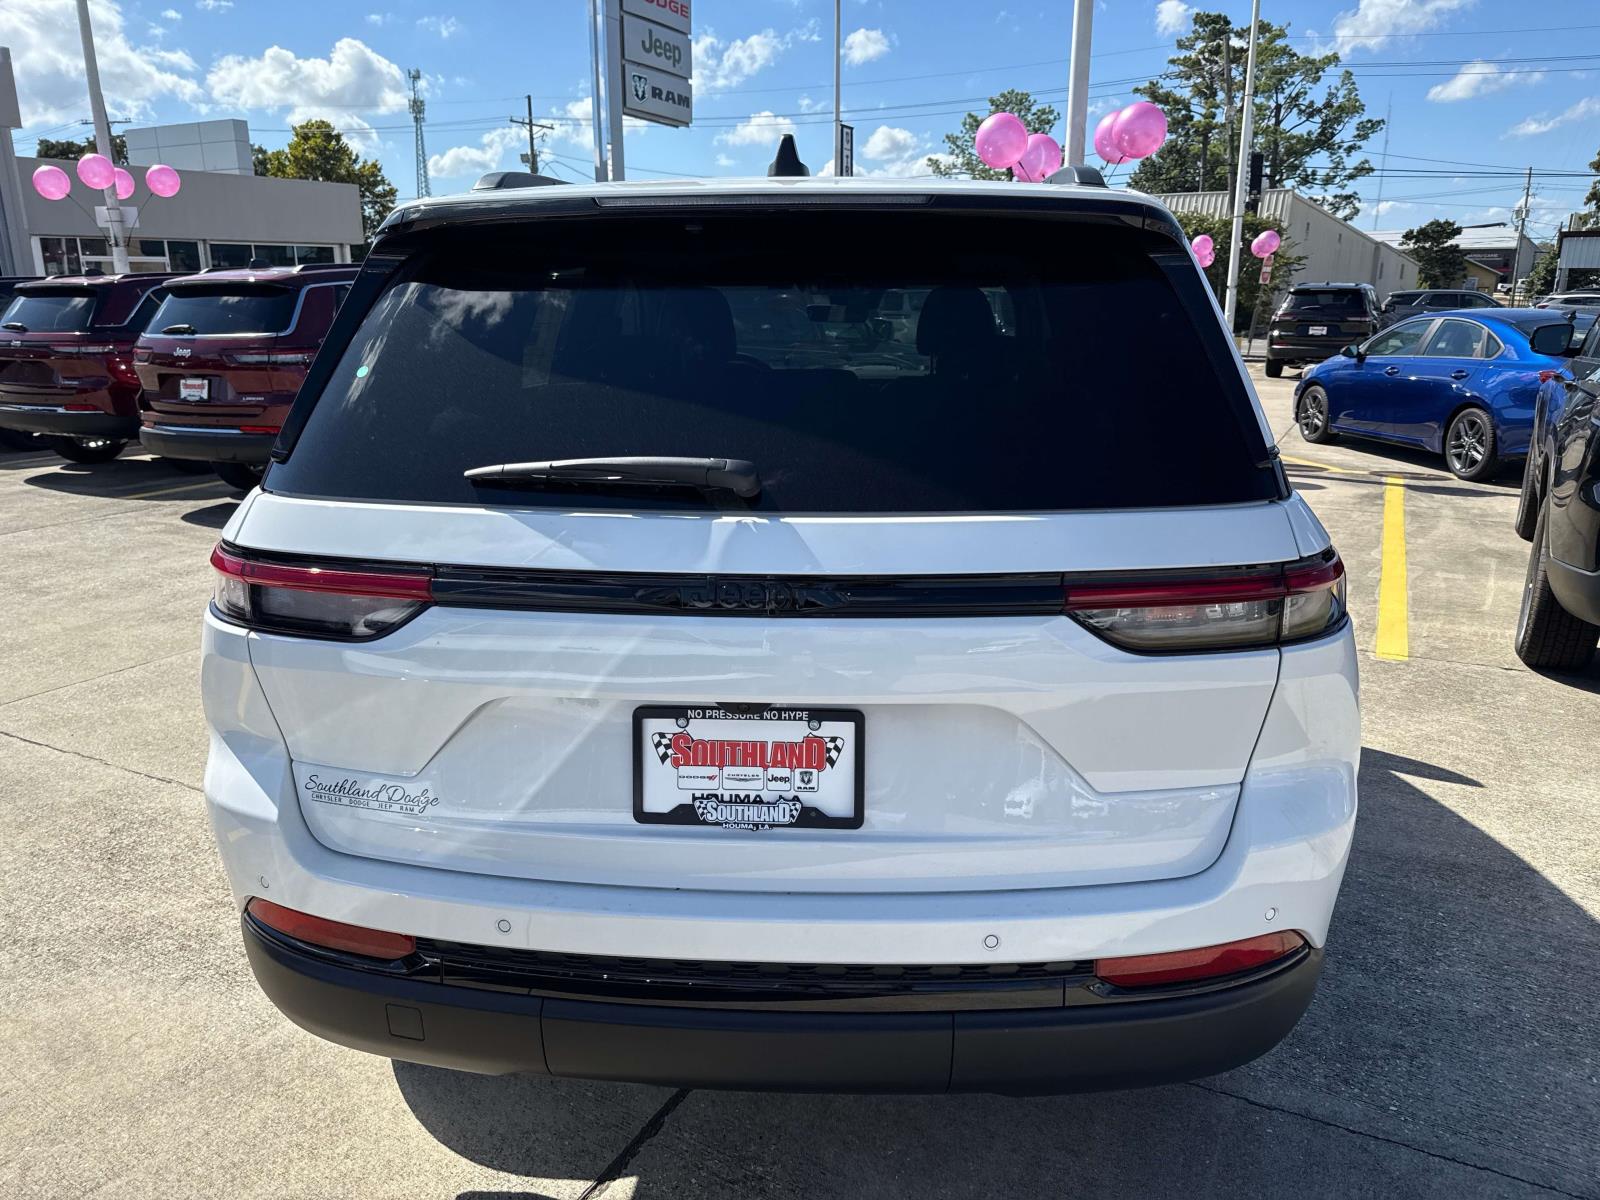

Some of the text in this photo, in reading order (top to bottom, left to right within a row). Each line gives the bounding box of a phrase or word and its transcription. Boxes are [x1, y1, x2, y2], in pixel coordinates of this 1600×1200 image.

[641, 28, 682, 67] Jeep
[651, 86, 690, 109] RAM
[173, 346, 192, 358] Jeep
[688, 575, 795, 616] Jeep
[687, 709, 703, 719] NO
[763, 711, 779, 720] NO
[781, 711, 809, 720] HYPE
[671, 733, 826, 772] SOUTHLAND
[767, 774, 790, 783] Jeep
[304, 774, 440, 814] Southland Dodge
[311, 793, 342, 803] CHRYSLER
[348, 799, 370, 807] DODGE
[399, 805, 415, 813] RAM
[706, 801, 792, 823] SOUTHLAND
